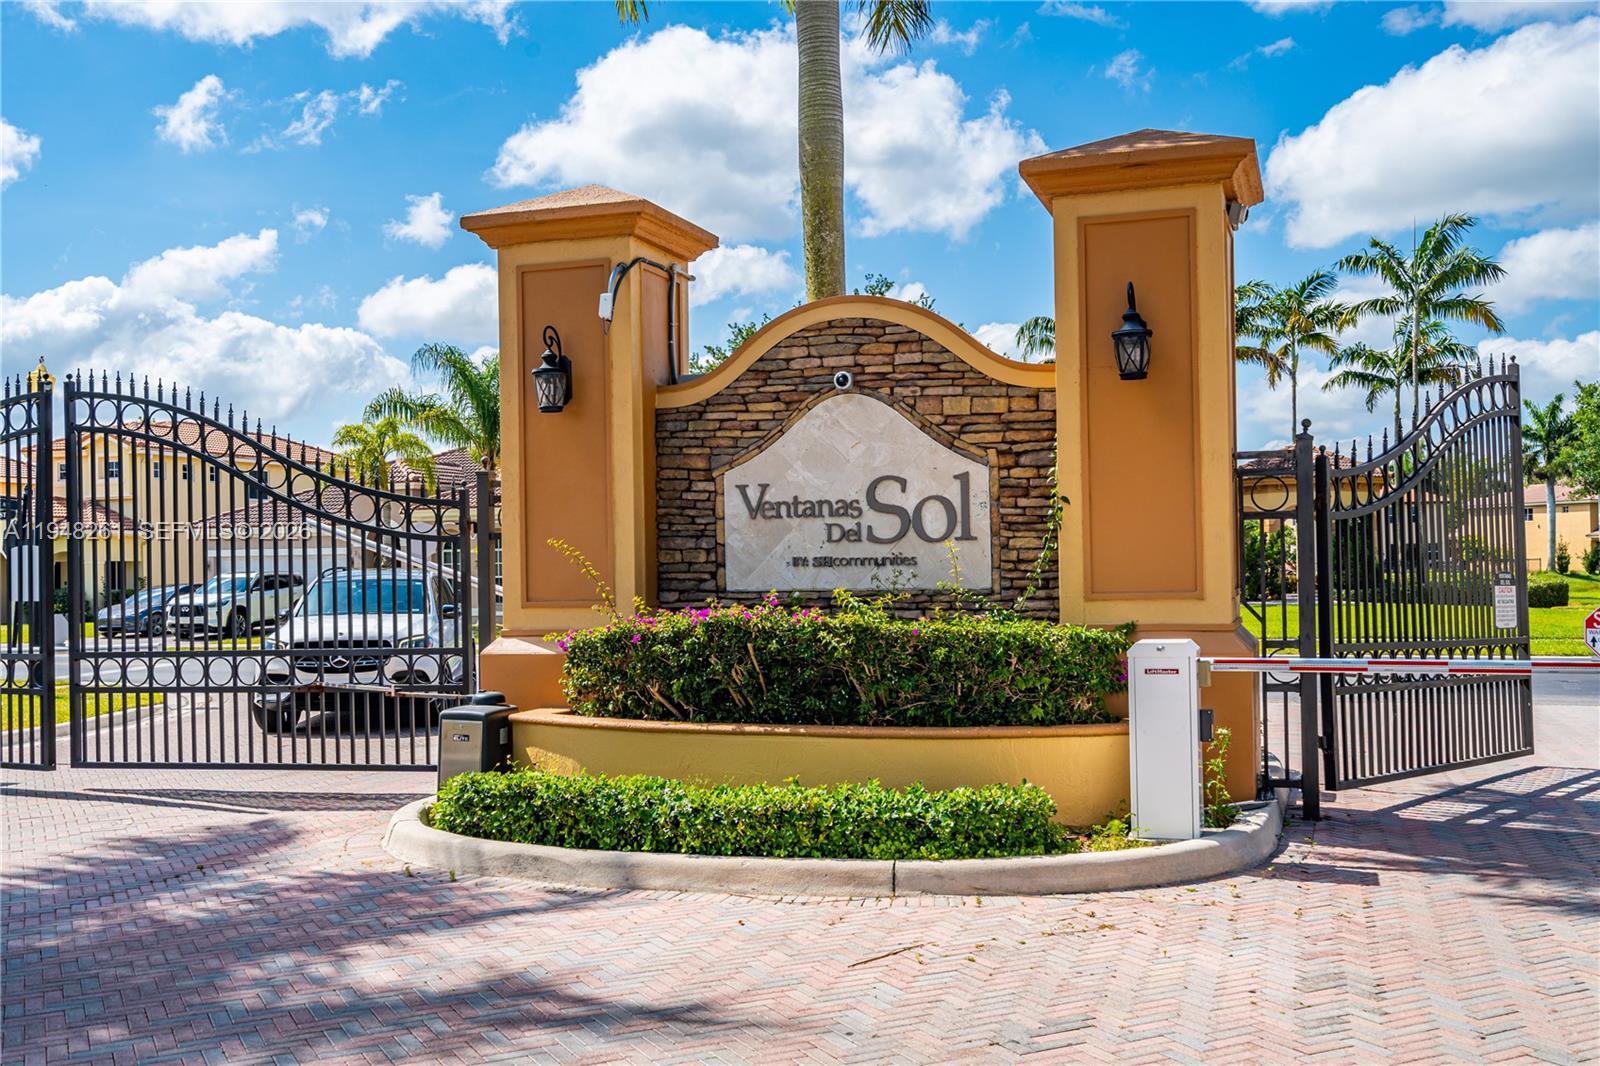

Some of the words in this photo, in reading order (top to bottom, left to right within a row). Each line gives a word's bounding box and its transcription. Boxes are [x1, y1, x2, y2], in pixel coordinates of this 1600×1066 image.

[735, 483, 863, 520] Ventanas
[825, 522, 862, 544] Del
[865, 471, 978, 544] Sol
